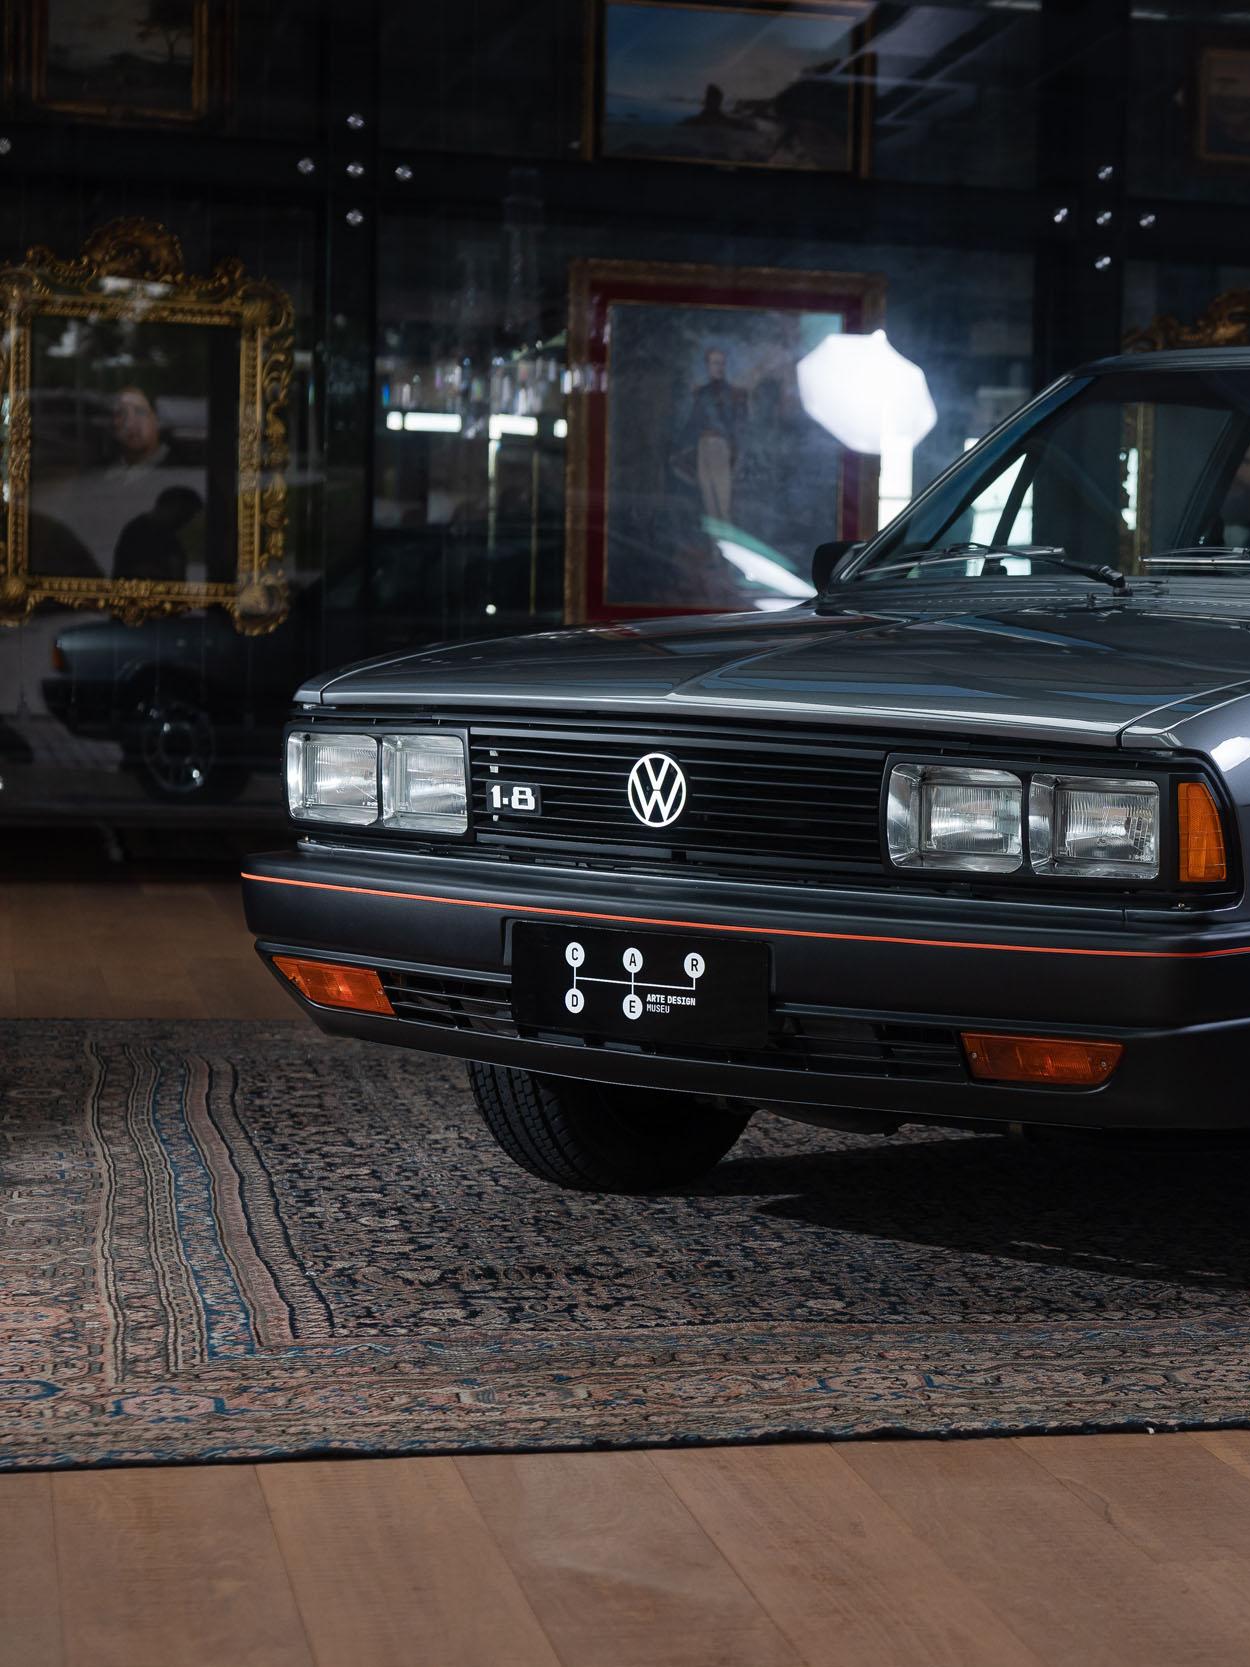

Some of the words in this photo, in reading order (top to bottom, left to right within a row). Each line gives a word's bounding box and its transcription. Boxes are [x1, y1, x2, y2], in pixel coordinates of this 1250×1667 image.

[491, 785, 536, 810] 1.8
[629, 754, 686, 826] VW
[646, 994, 666, 1003] ARTE
[667, 996, 696, 1006] DESIGN
[646, 1004, 670, 1013] MUSEU
